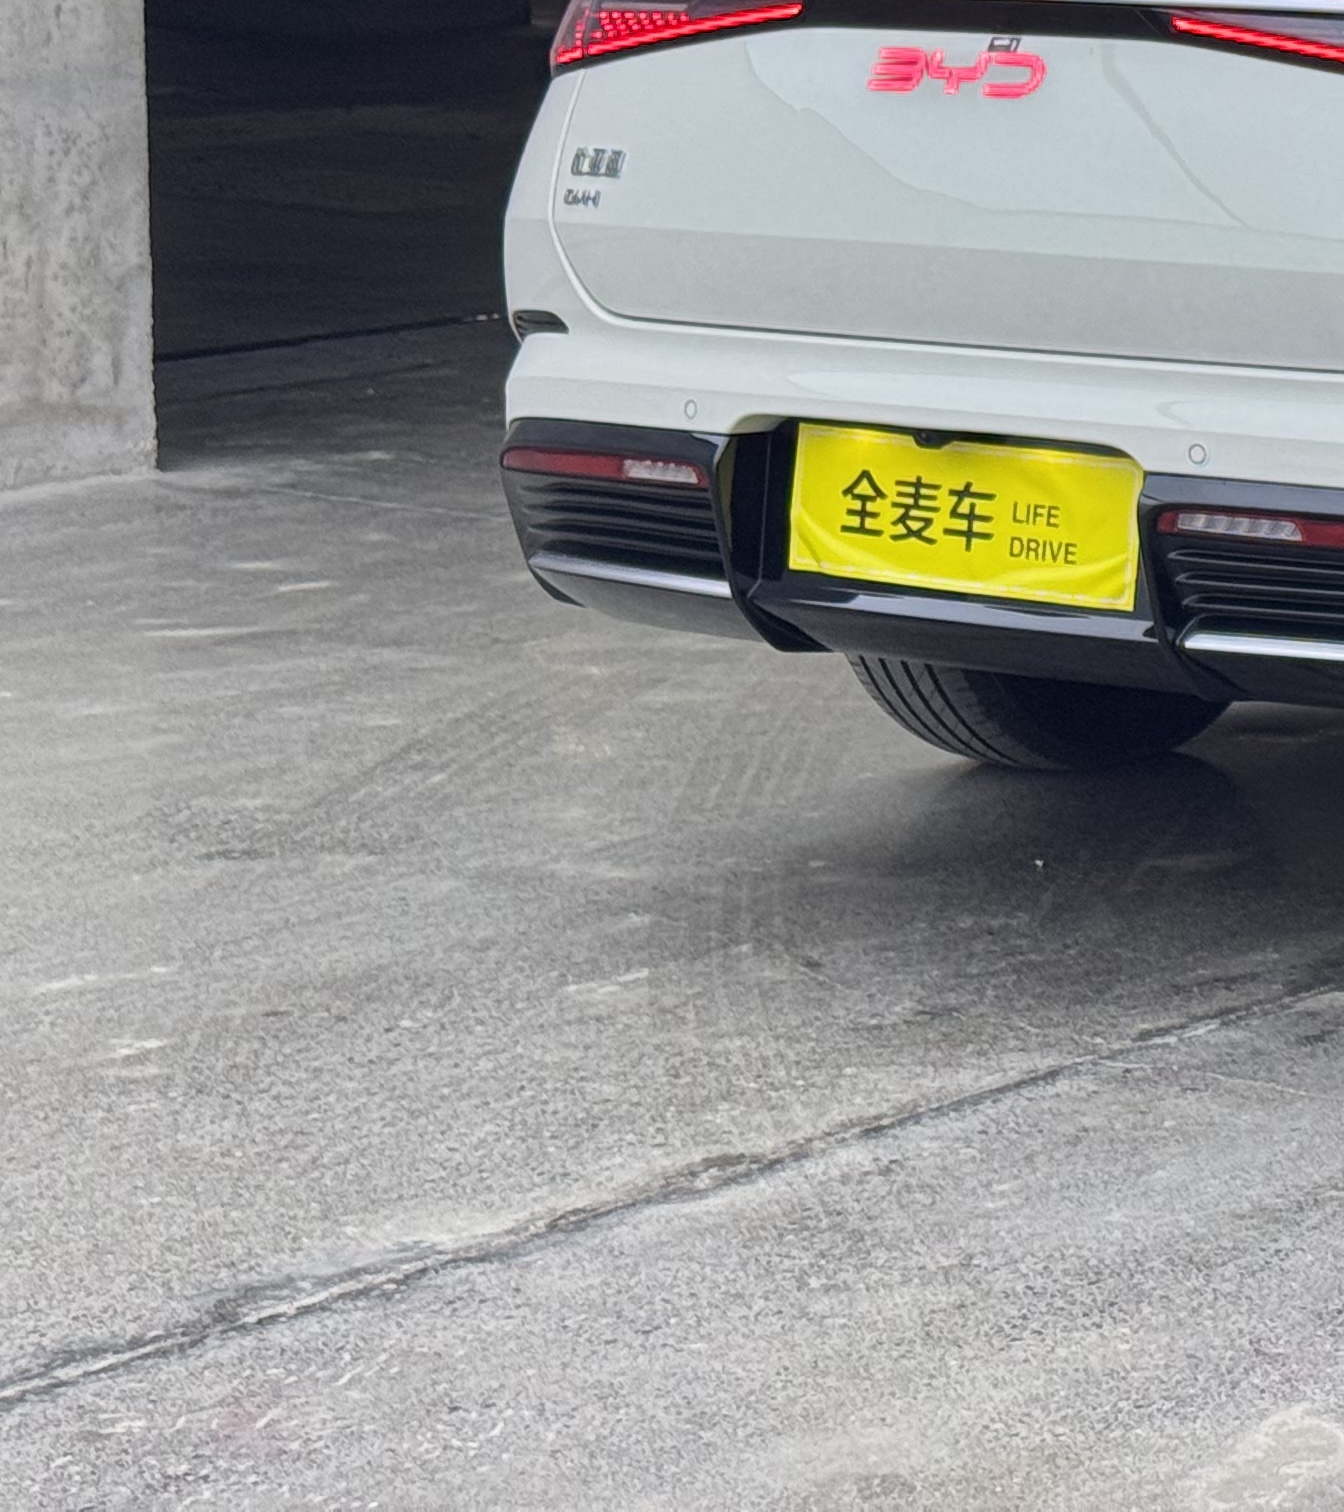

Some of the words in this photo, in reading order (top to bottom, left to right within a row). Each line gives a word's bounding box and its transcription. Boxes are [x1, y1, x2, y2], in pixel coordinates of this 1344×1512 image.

[866, 45, 1047, 99] BYD
[840, 469, 998, 553] 全麦车
[1012, 500, 1061, 529] LIFE
[1008, 536, 1079, 566] DRIVE
